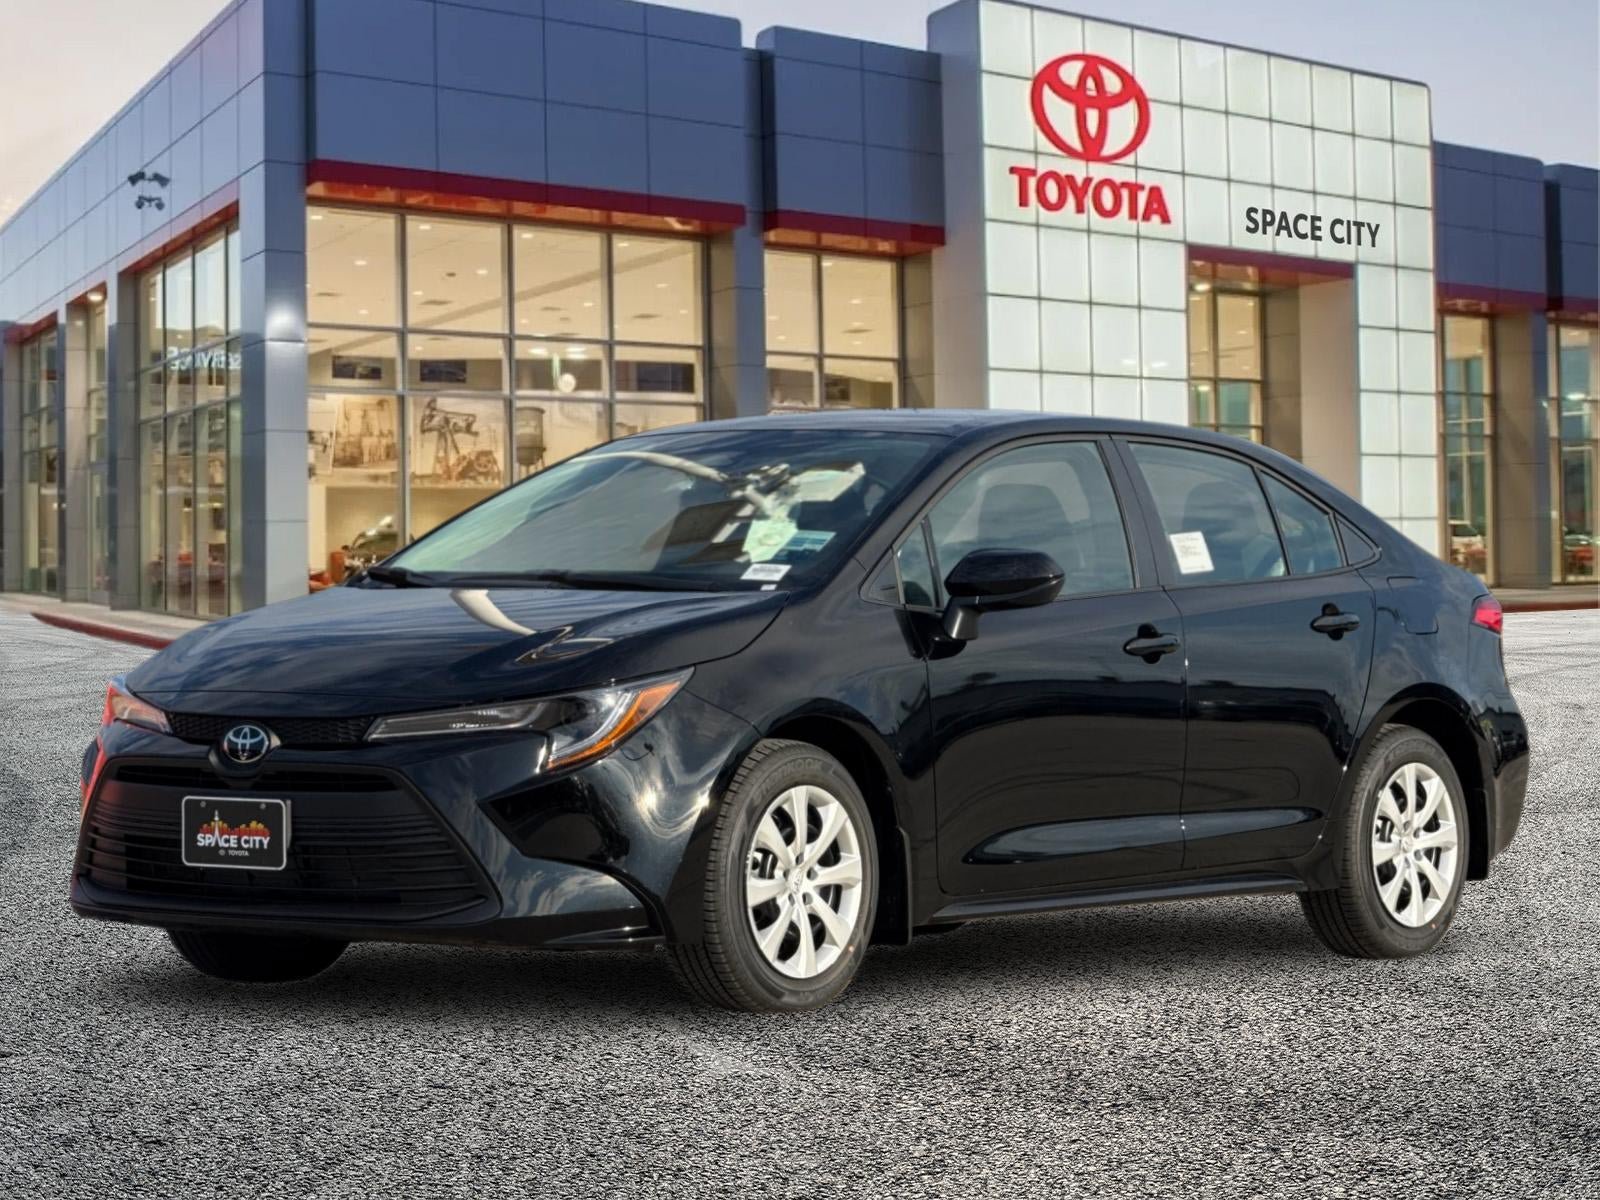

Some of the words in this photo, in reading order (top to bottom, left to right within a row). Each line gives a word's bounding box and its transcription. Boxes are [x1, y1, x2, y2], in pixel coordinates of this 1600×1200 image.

[1009, 166, 1172, 225] TOYOTA
[1245, 206, 1323, 242] SPACE
[1329, 218, 1380, 248] CITY
[196, 832, 239, 848] SPACE
[240, 835, 271, 849] CITY
